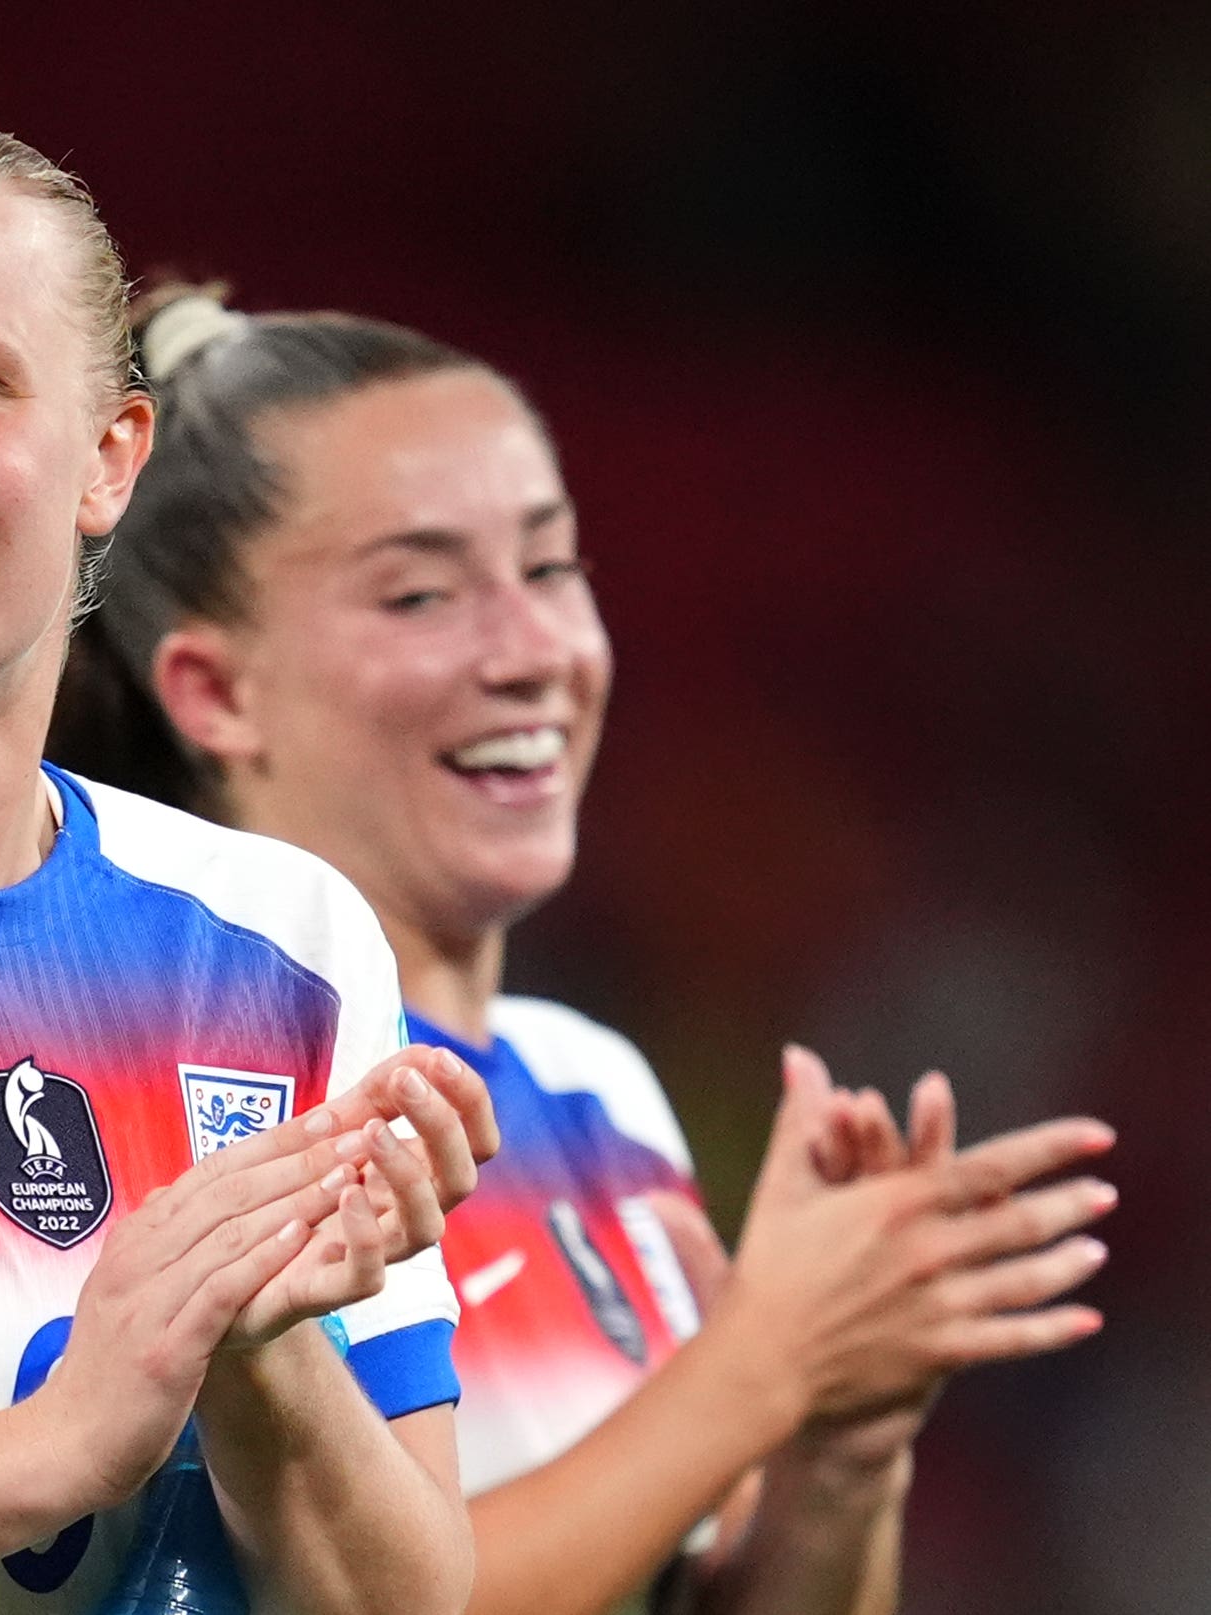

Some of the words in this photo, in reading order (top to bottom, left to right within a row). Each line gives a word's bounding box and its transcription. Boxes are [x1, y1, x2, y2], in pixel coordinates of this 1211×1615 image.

[23, 1159, 64, 1177] UEFA
[10, 1182, 87, 1196] EUROPEAN
[11, 1197, 94, 1212] CHAMPIONS
[37, 1215, 80, 1231] 2022
